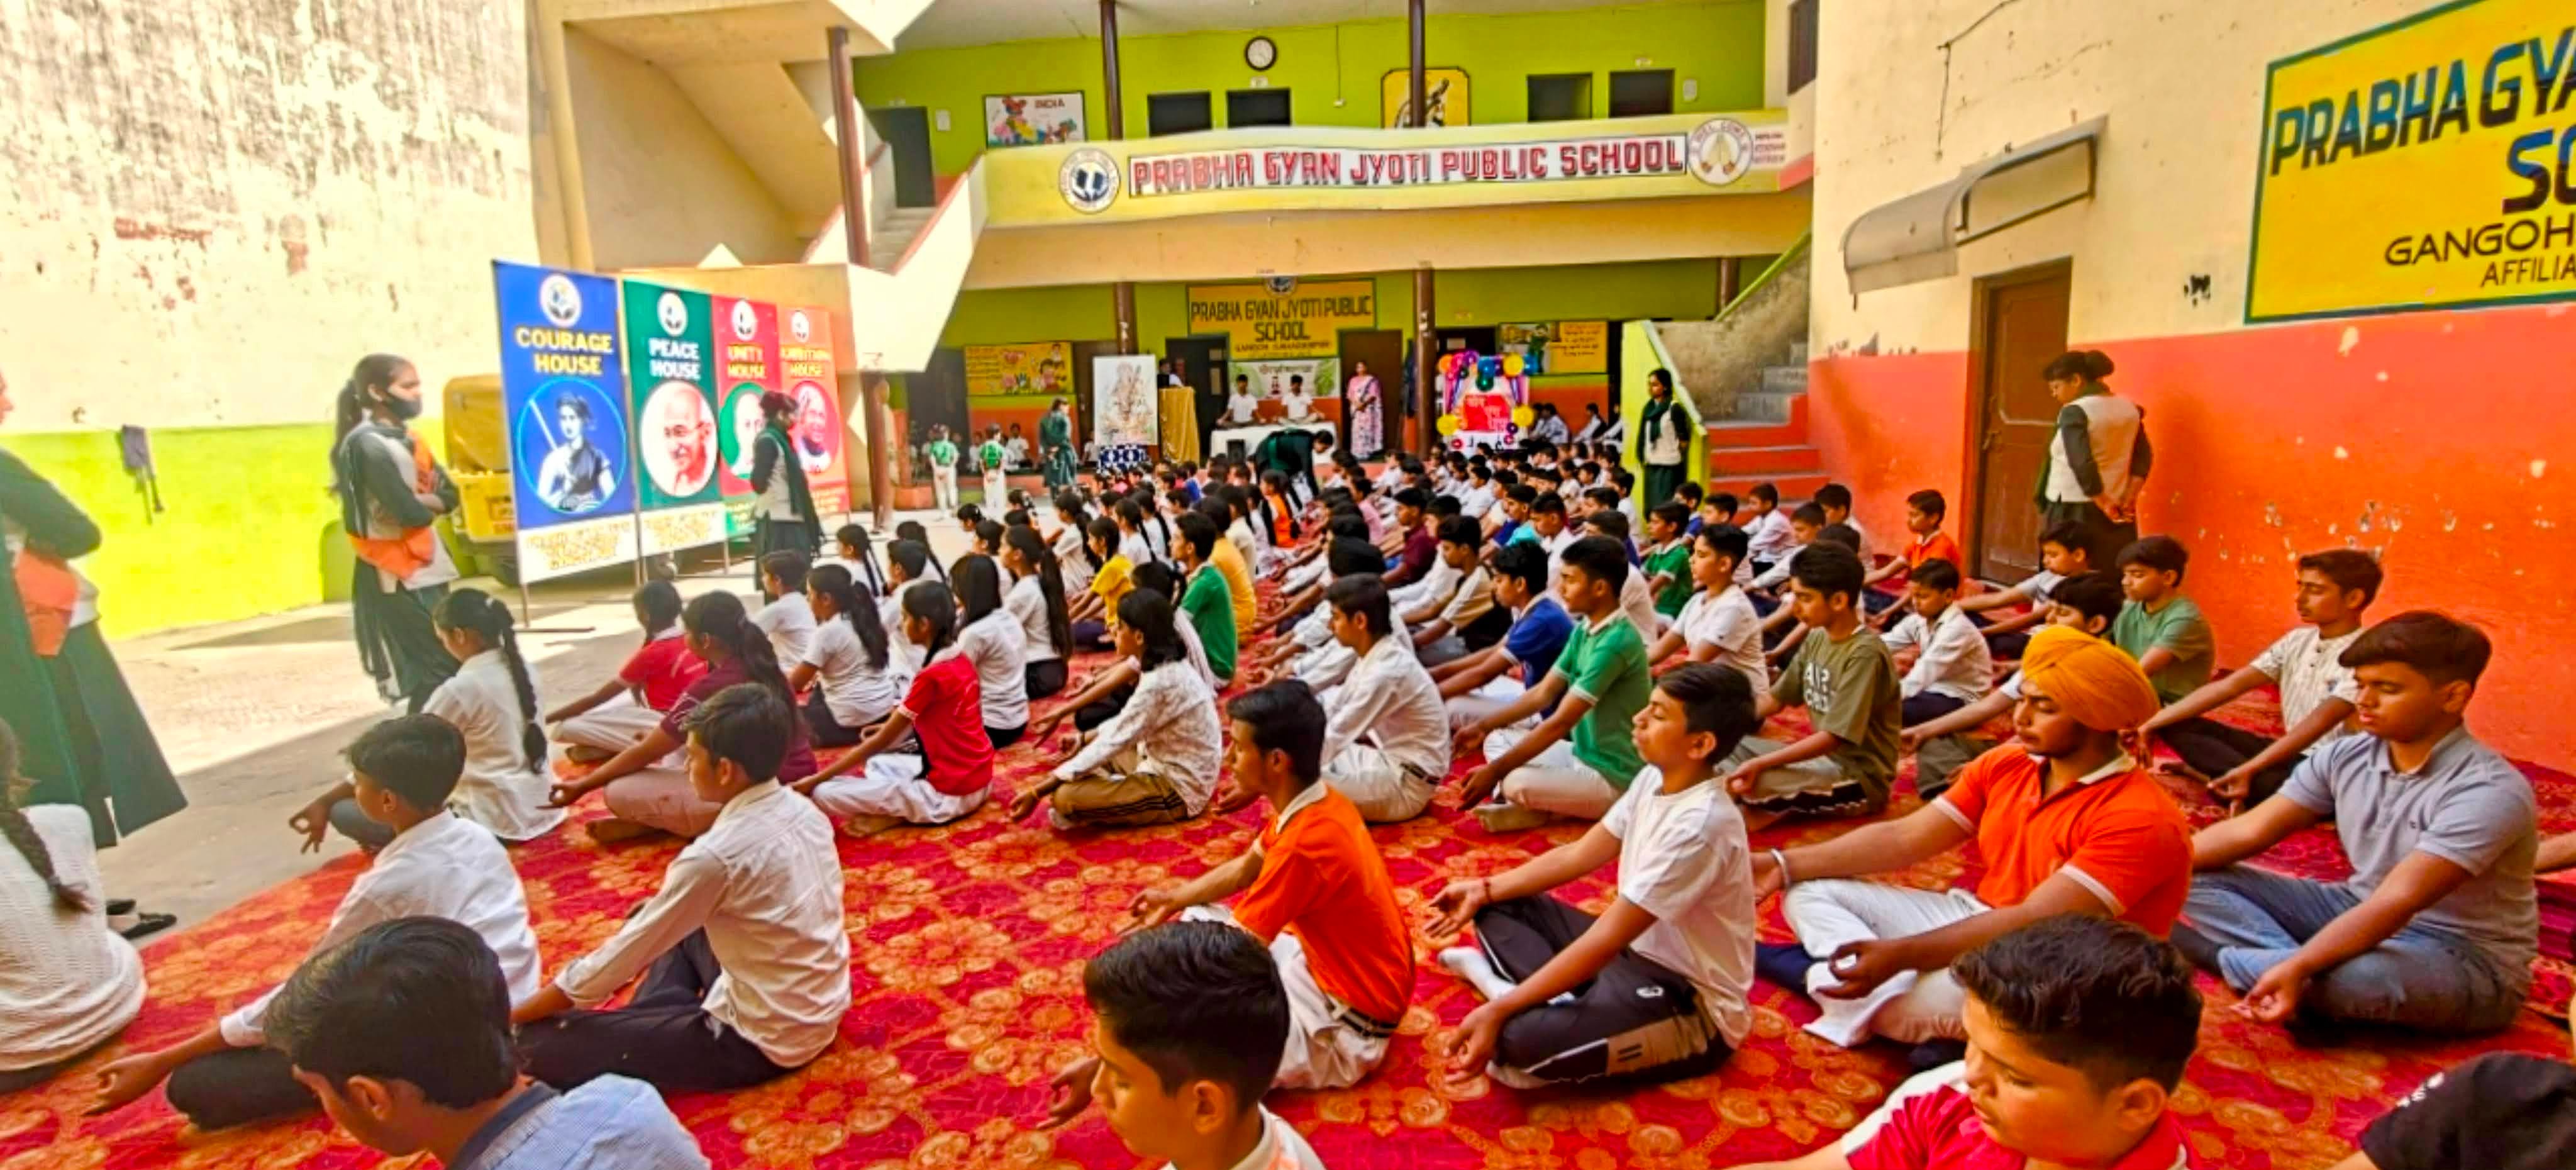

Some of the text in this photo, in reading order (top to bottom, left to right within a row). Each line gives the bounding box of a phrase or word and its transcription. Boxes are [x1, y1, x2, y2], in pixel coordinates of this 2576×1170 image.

[1035, 98, 1065, 108] INDIA
[2270, 60, 2470, 177] PRABHA
[1133, 152, 1253, 194] PRABHA
[1263, 152, 1341, 185] GYAN
[1350, 151, 1430, 185] JYOTI
[1440, 146, 1547, 182] PUBLIC
[1560, 140, 1683, 176] SCHOOL
[2385, 212, 2575, 267] GANGOH
[1191, 295, 1372, 322] PRABHA GYAN JYOTI PUBLIC
[516, 326, 613, 354] COURAGE
[1254, 321, 1311, 342] SCHOOL
[648, 337, 699, 359] PEACE
[728, 345, 763, 361] UNITY
[535, 352, 602, 375] HOUSE
[650, 358, 701, 380] HOUSE
[727, 363, 766, 379] HOUSE
[790, 362, 823, 376] HOUSE
